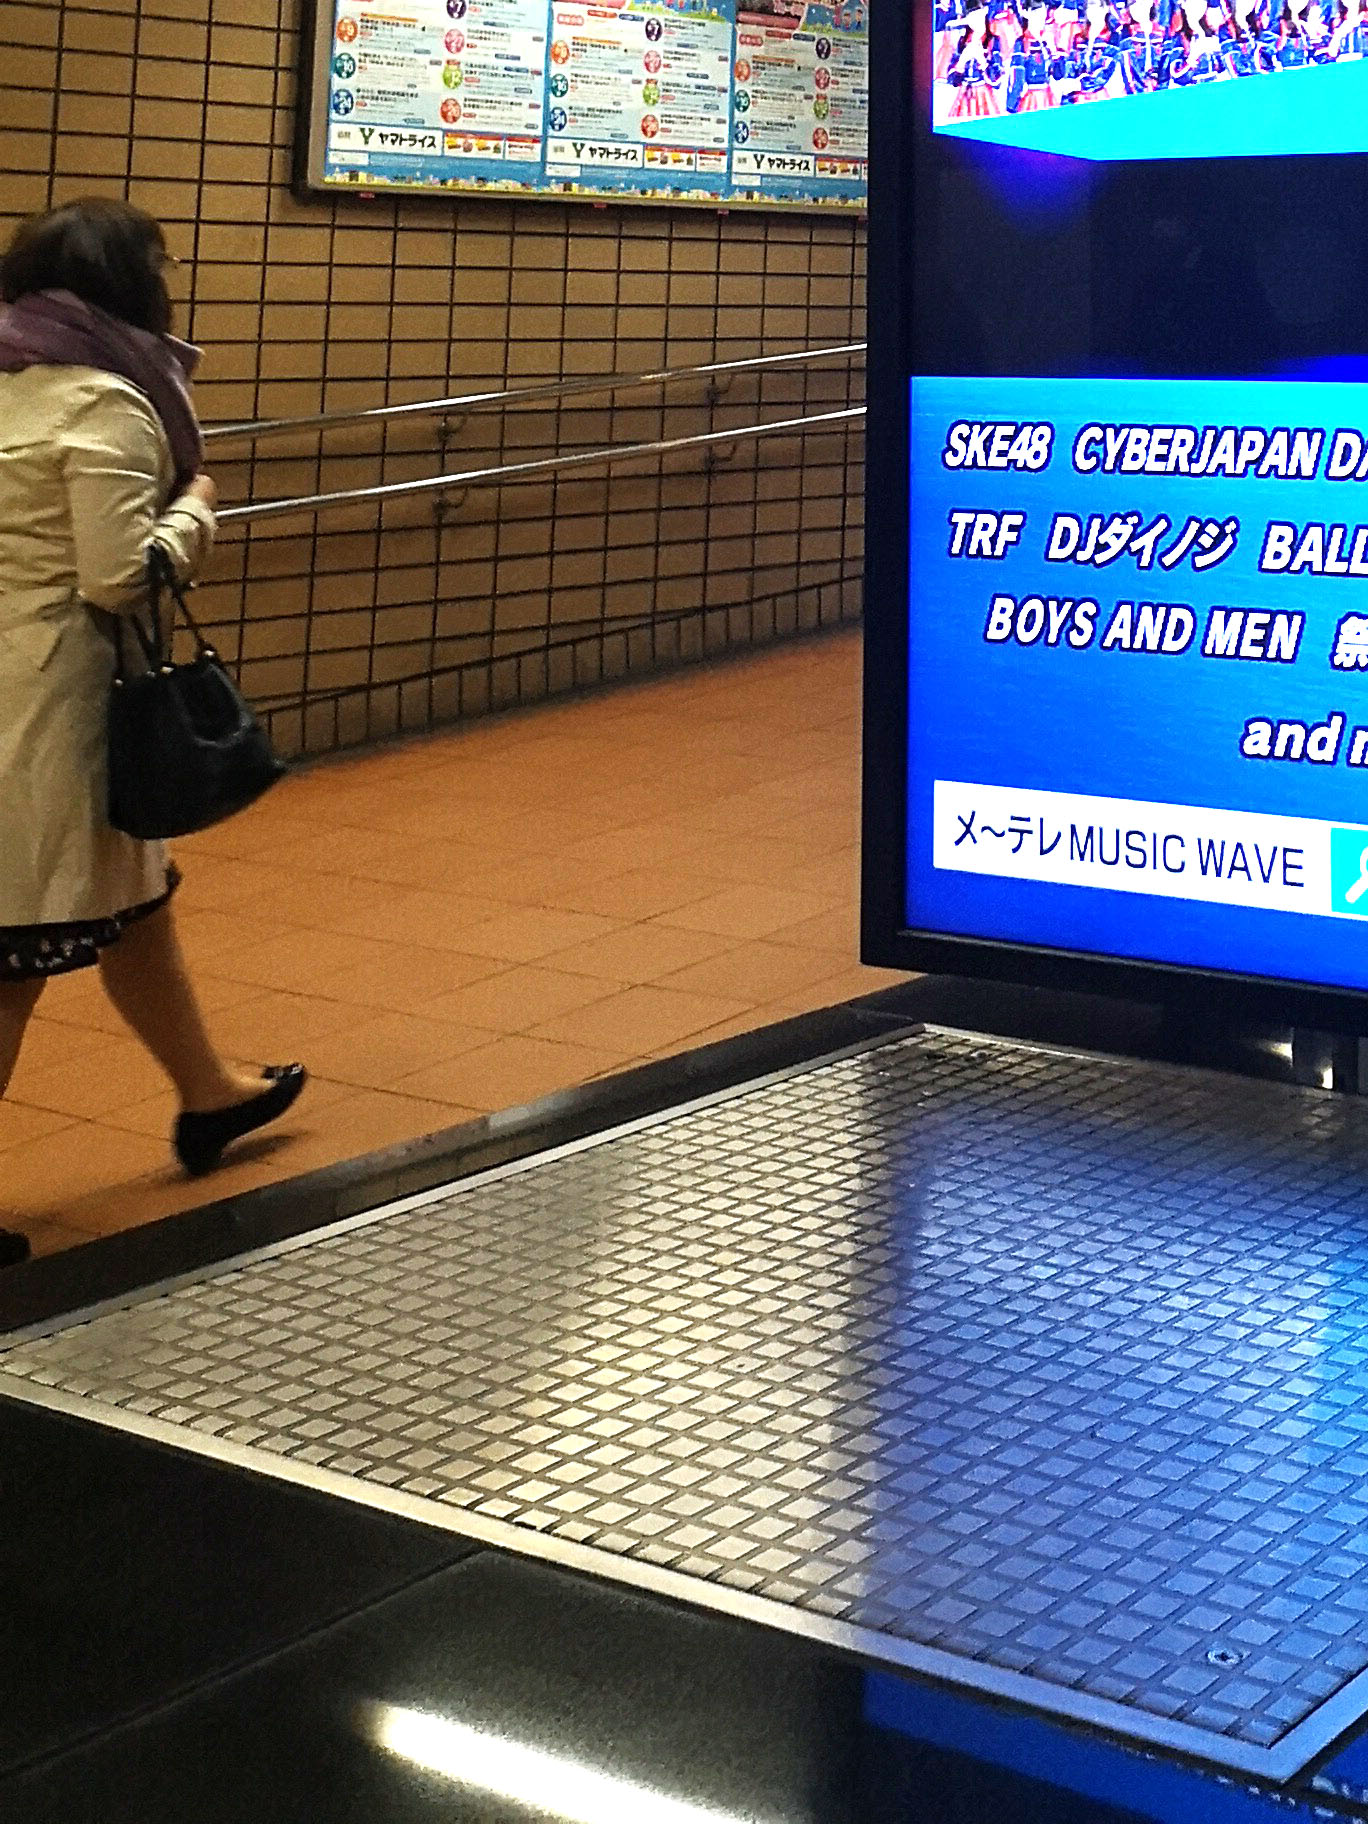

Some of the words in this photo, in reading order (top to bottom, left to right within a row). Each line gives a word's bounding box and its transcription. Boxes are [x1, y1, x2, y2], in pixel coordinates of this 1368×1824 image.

[378, 132, 437, 149] ヤマトライス
[588, 146, 638, 161] ヤマトライス
[767, 157, 811, 172] ヤマトライス
[943, 421, 1054, 471] SKE48
[1073, 424, 1323, 477] CYBERJAPAN
[948, 509, 1025, 558] TRF
[1046, 511, 1238, 570] DJダイノジ
[984, 596, 1099, 647] BOYS
[1102, 601, 1195, 655] AND
[1202, 609, 1305, 663] MEN
[1242, 713, 1345, 761] and
[1197, 838, 1306, 888] WAVE
